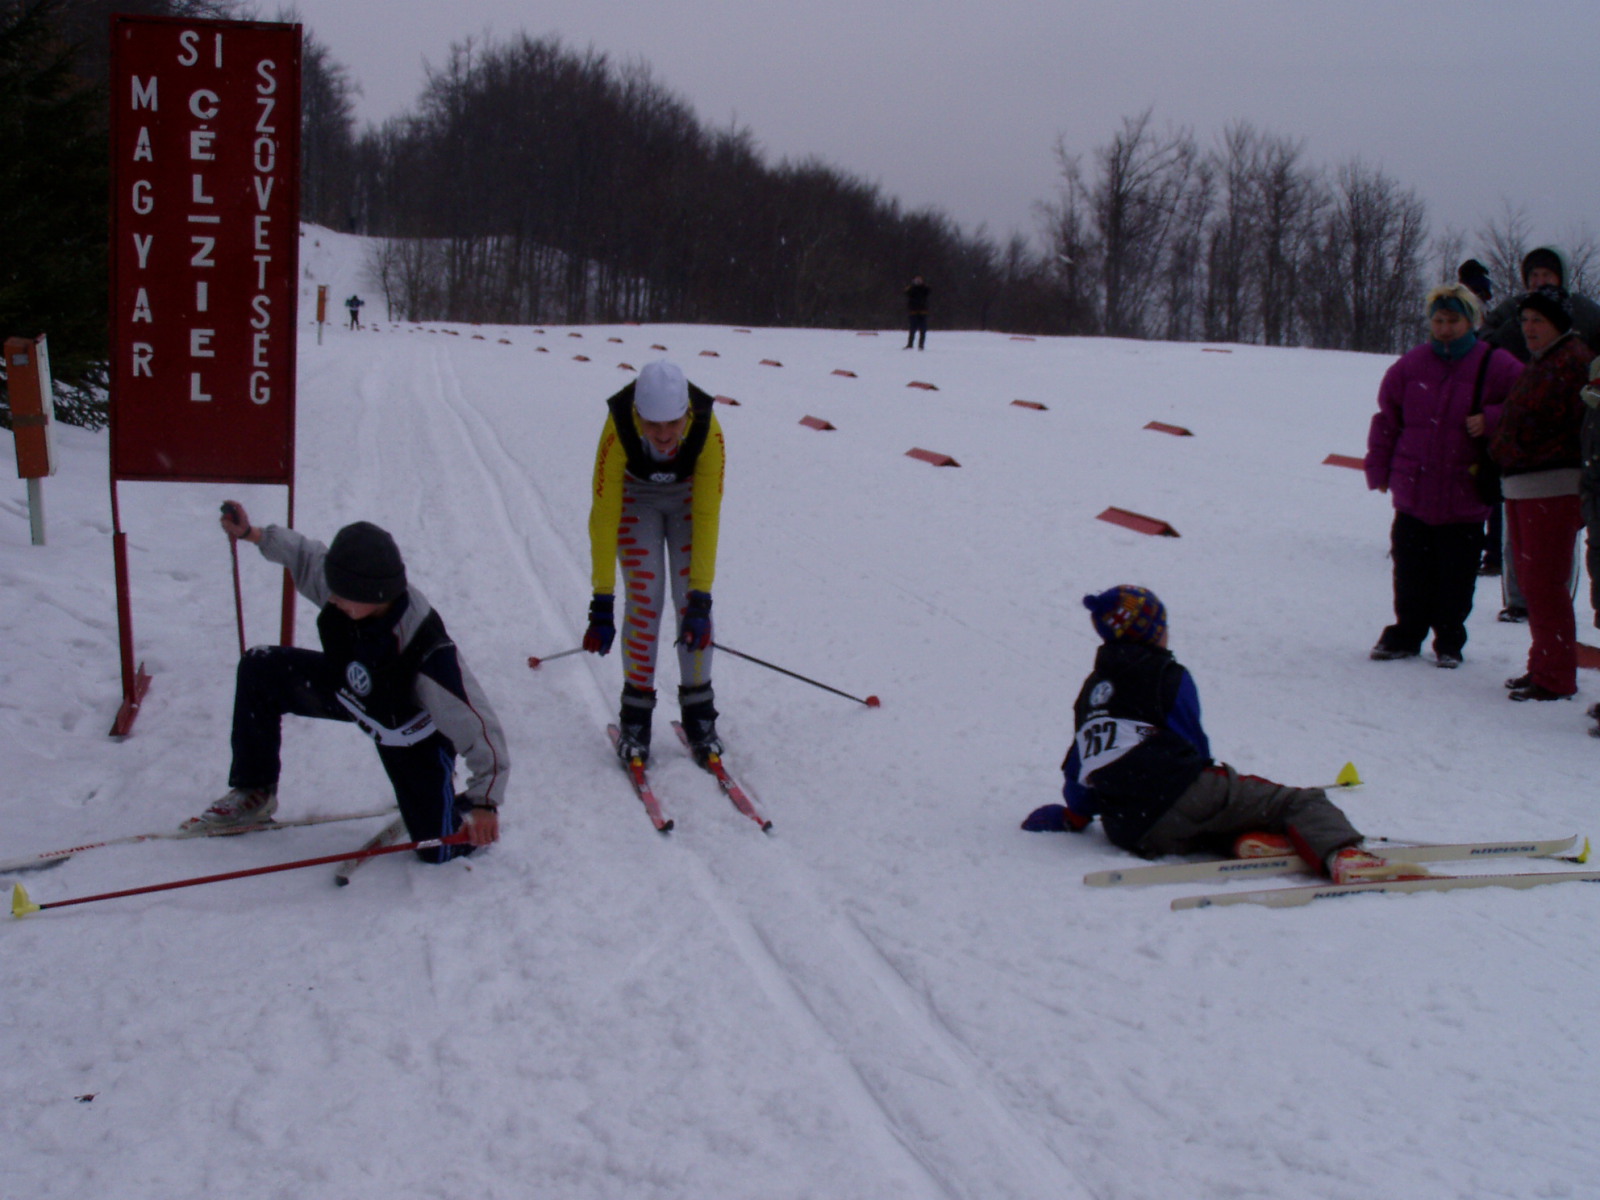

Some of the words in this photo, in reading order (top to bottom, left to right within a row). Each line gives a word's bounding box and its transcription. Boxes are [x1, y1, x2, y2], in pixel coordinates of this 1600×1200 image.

[177, 30, 223, 69] SI
[131, 75, 159, 377] MAGYAR
[249, 59, 277, 405] SZÖVETSÉG
[1083, 721, 1119, 760] 262
